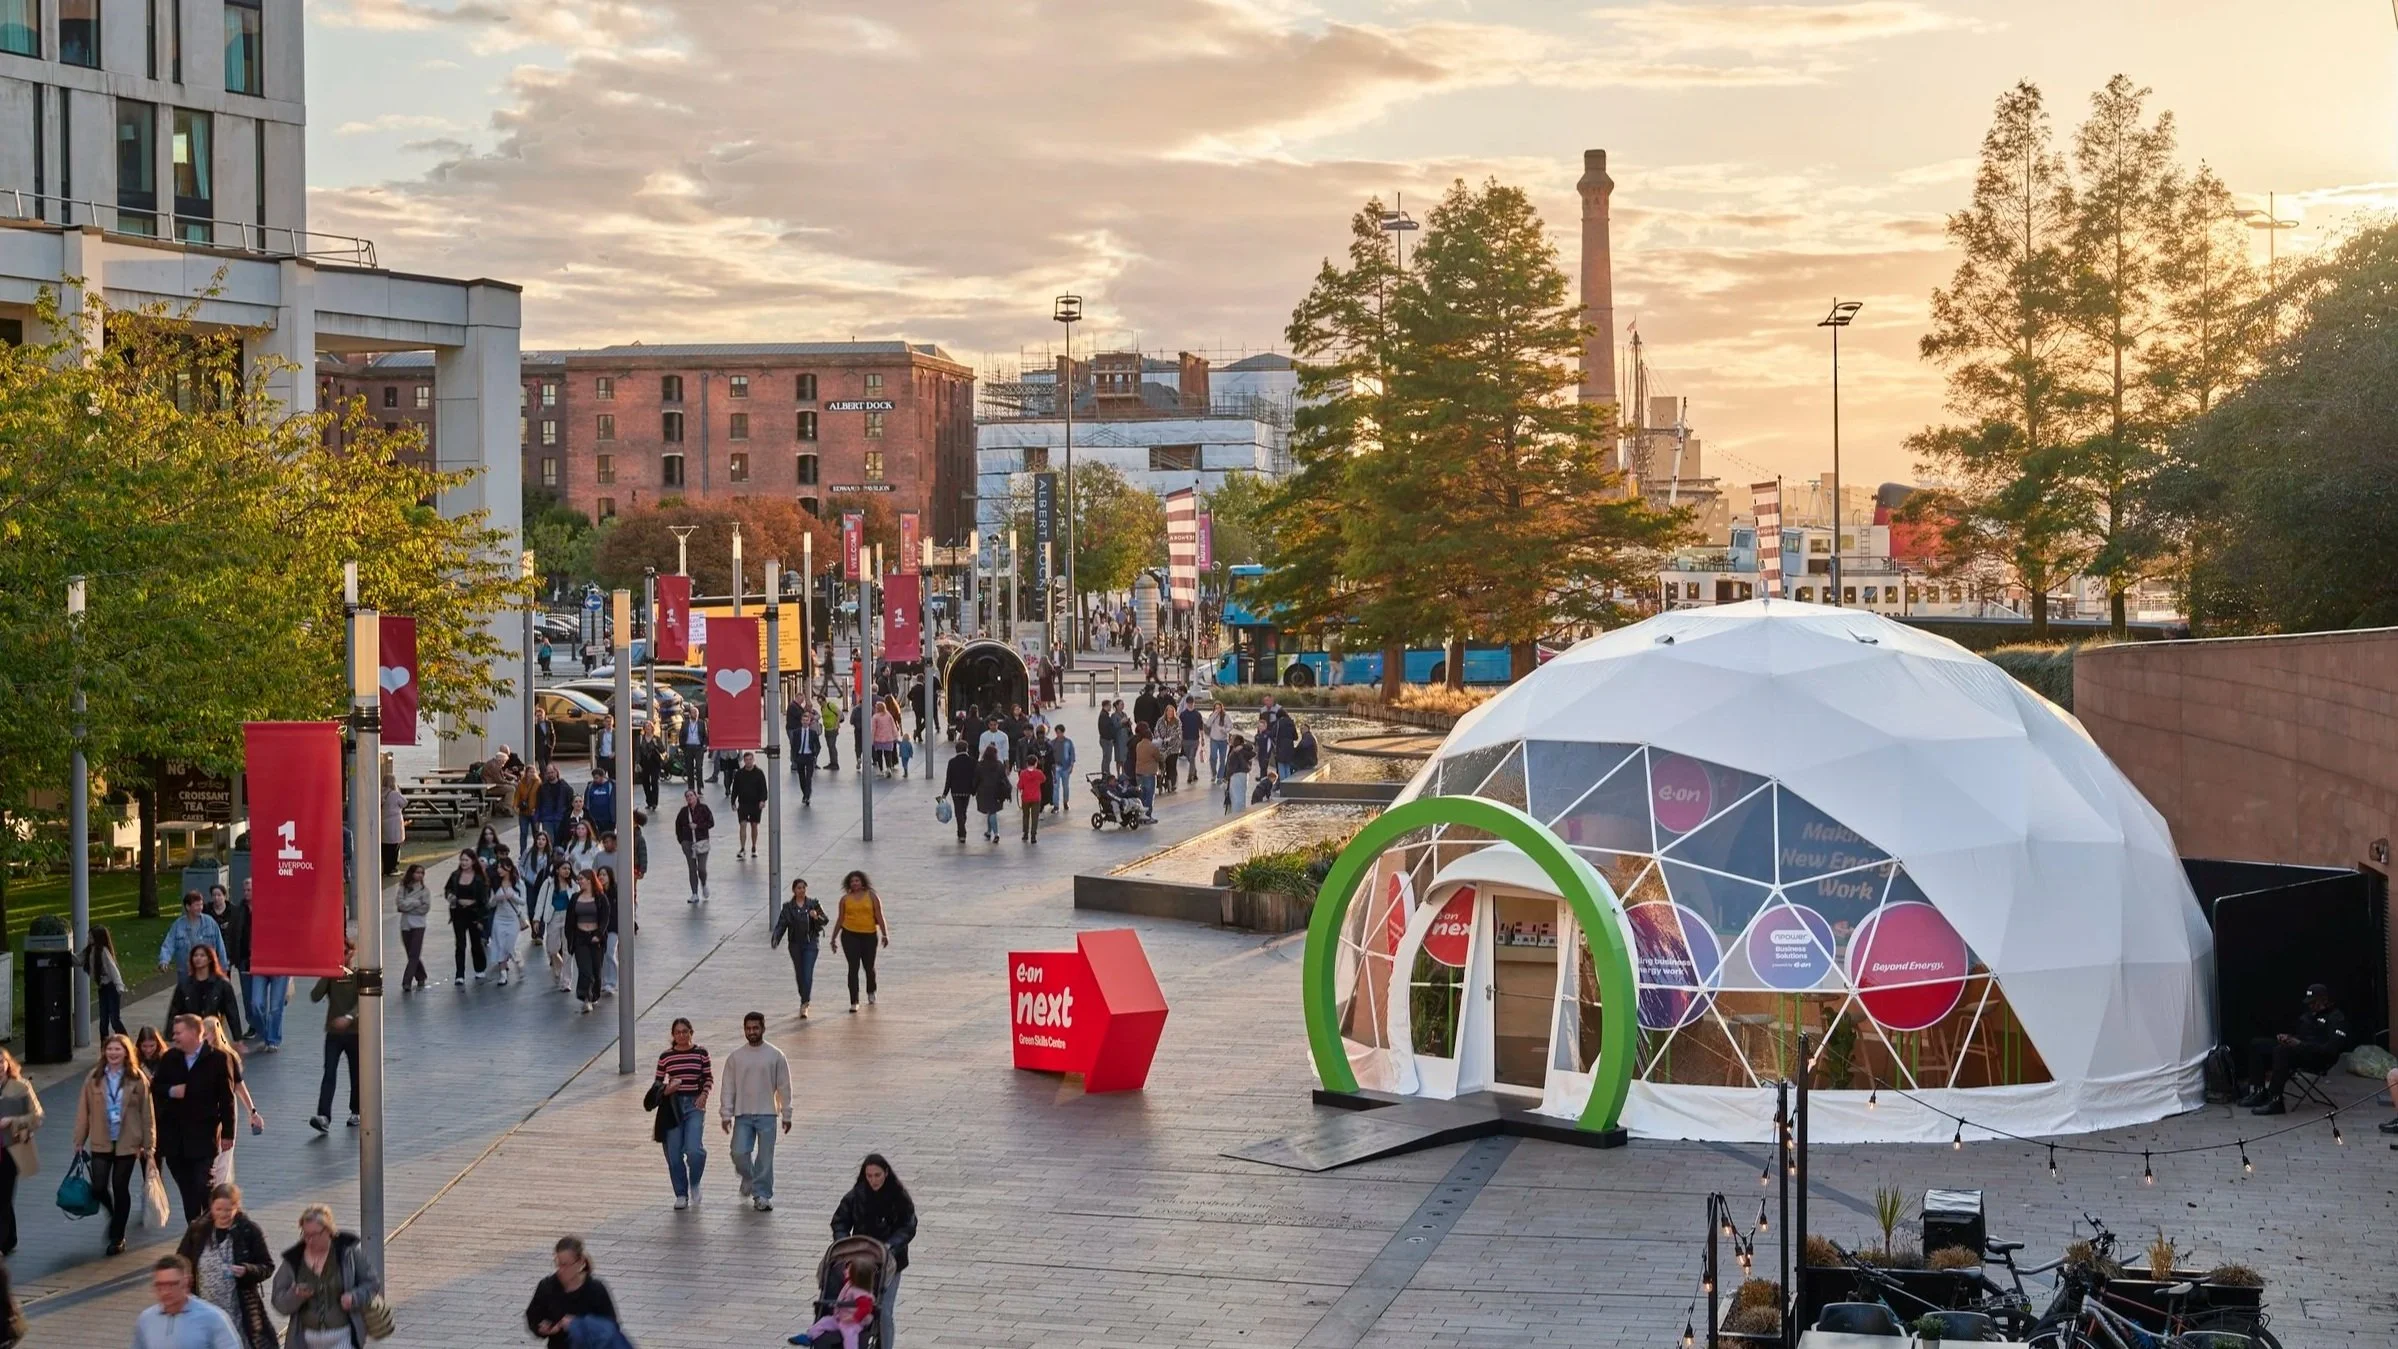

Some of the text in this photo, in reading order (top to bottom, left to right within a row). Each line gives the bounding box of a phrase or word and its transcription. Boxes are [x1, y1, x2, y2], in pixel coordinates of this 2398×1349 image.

[829, 401, 893, 411] ALBERT DOCK
[1038, 479, 1048, 539] ALBERT
[850, 531, 858, 570] WELCOME
[178, 791, 231, 801] CROISSANT
[184, 801, 204, 811] TEA
[181, 813, 206, 821] CAKES
[277, 820, 303, 860] 1
[1780, 847, 1826, 869] New
[278, 861, 315, 871] LIVERPOOL
[1817, 877, 1874, 900] Work
[1654, 957, 1692, 967] business
[1872, 961, 1945, 973] Beyond Energy.
[1662, 967, 1684, 975] work
[1016, 986, 1074, 1029] next
[1018, 1033, 1067, 1050] Green Skills Centre
